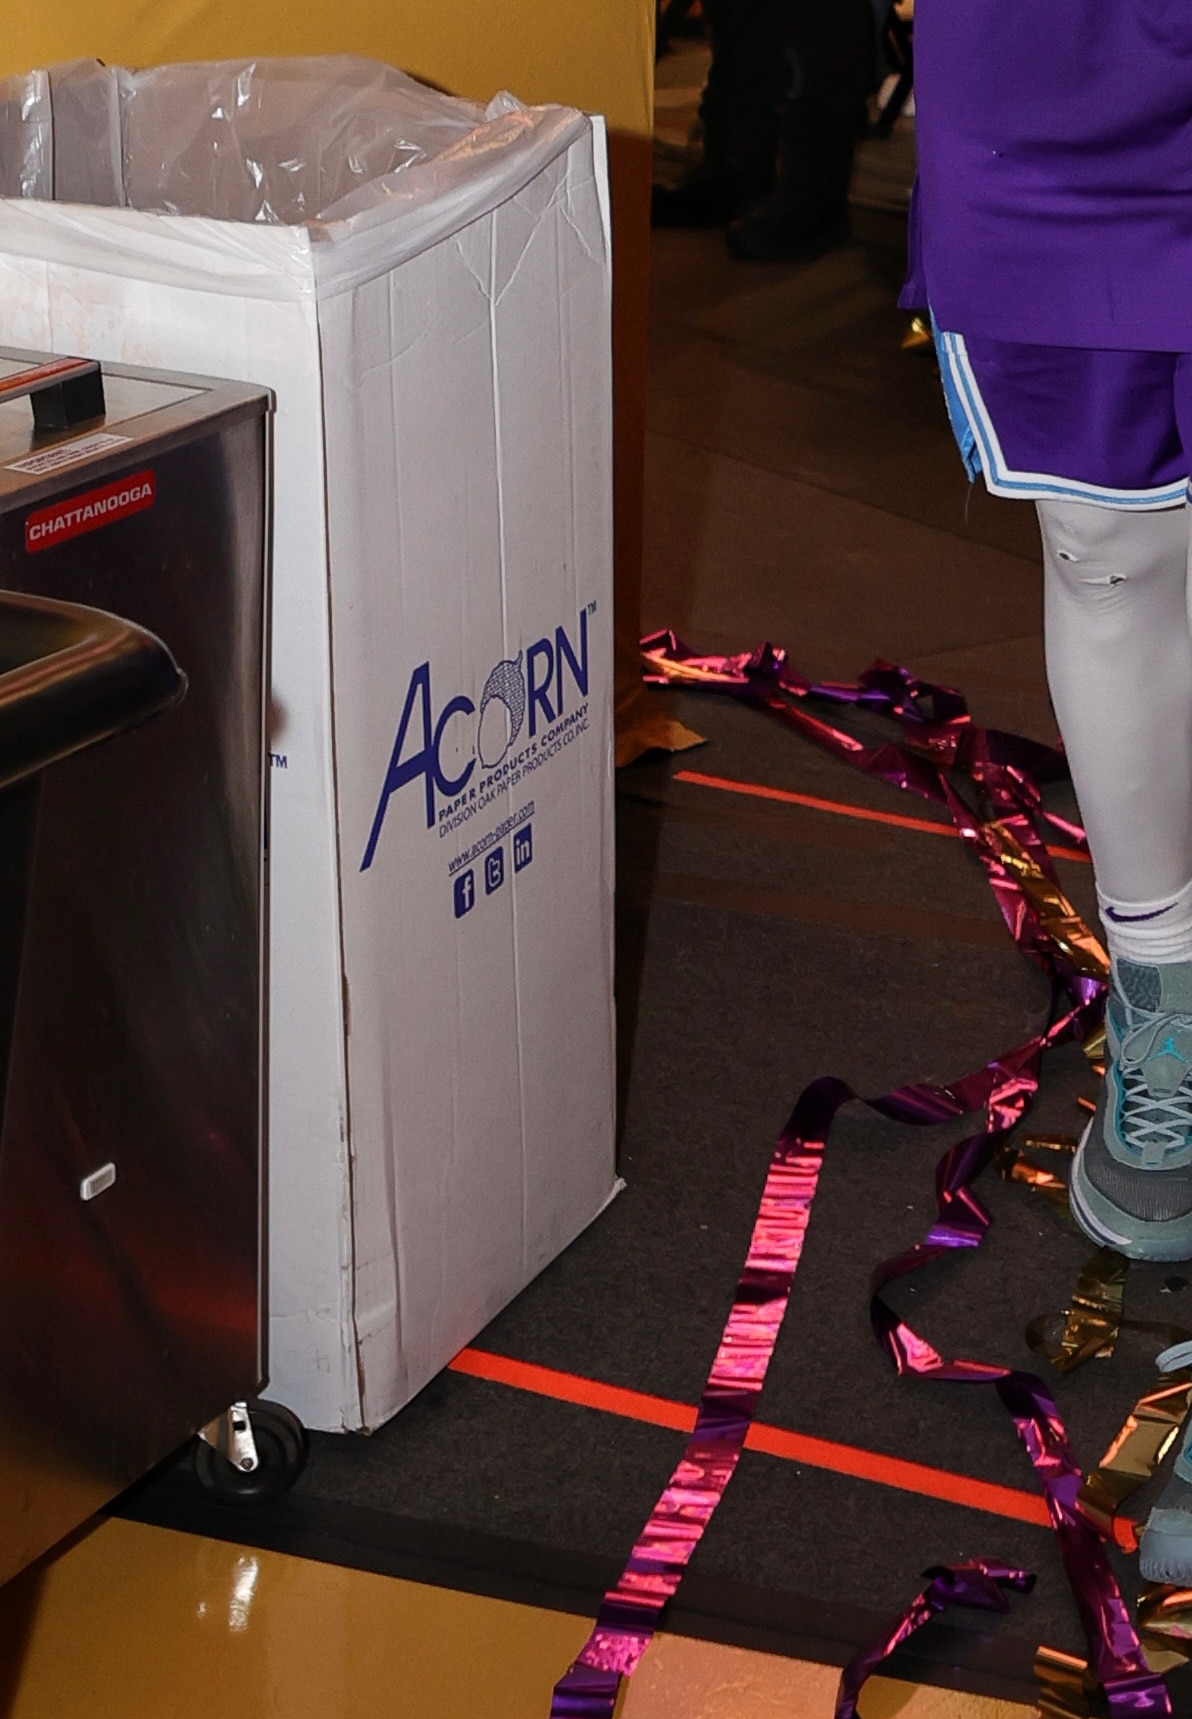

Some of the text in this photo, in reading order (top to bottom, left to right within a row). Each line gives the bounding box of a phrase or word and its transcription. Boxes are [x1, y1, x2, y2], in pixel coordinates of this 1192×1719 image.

[29, 482, 153, 541] CHATTANOOGA
[438, 702, 588, 822] PAPER PRODUCTS COMPANY
[439, 800, 478, 839] DIVISION
[478, 788, 497, 811] OAK
[496, 769, 522, 796] PAPER
[522, 739, 562, 776] PRODUCTS
